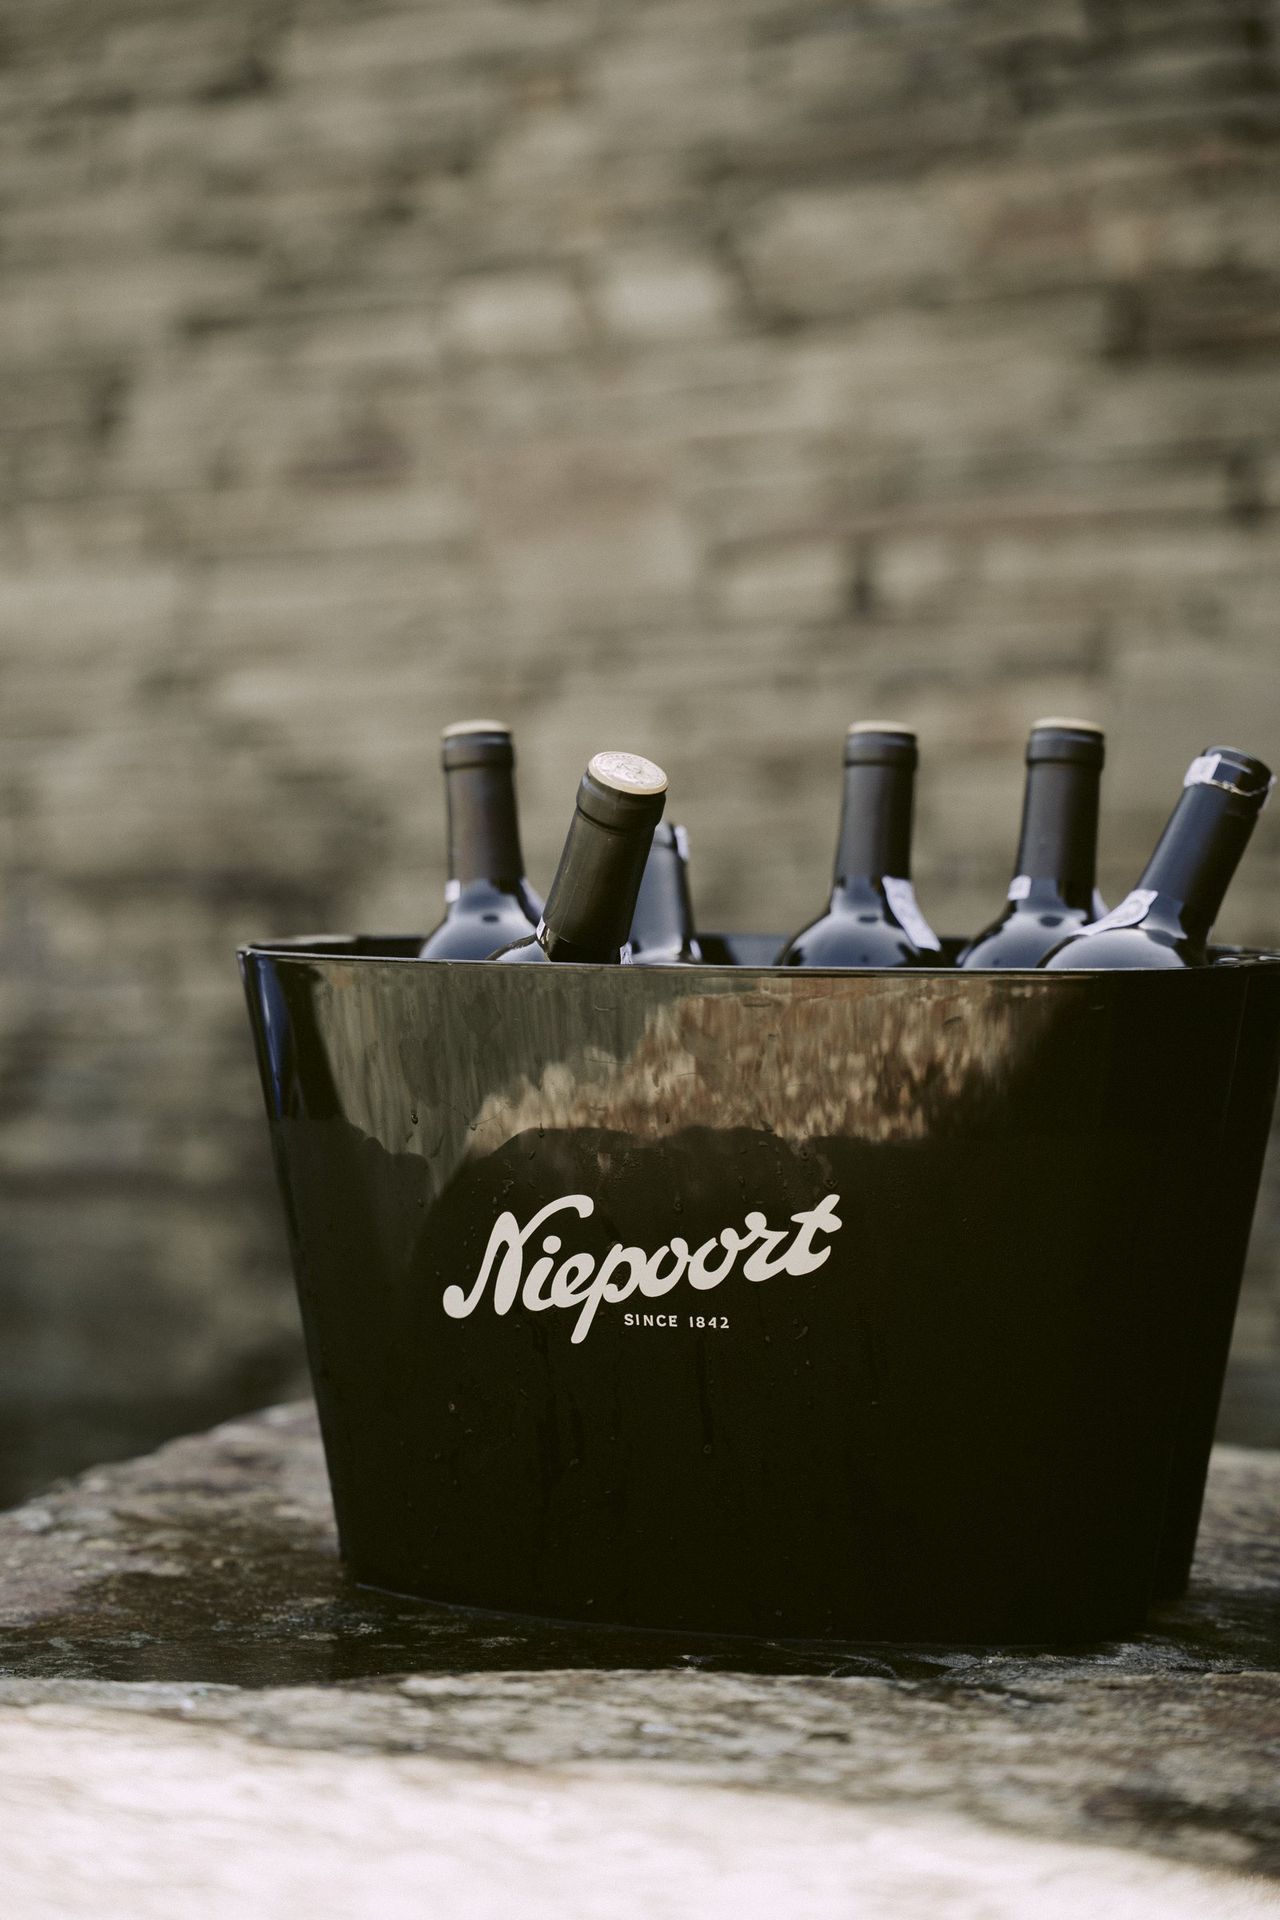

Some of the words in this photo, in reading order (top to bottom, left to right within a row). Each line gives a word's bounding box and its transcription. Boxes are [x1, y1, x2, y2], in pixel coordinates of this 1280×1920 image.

[442, 1193, 843, 1345] Niepoort
[624, 1313, 678, 1327] SINCE
[689, 1316, 730, 1329] 1842
